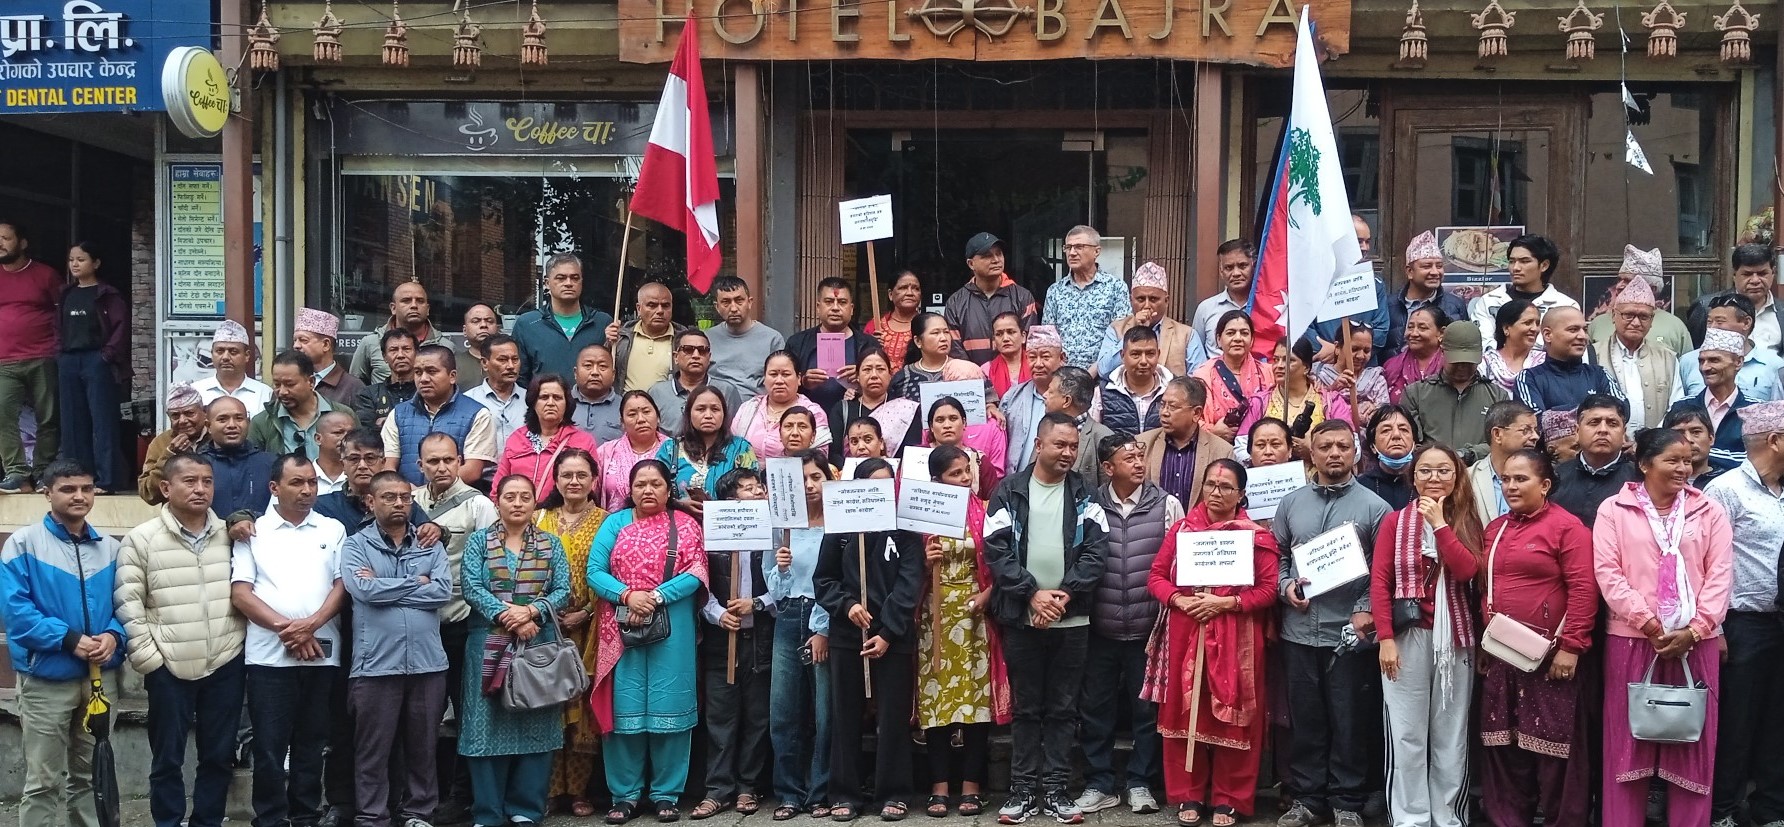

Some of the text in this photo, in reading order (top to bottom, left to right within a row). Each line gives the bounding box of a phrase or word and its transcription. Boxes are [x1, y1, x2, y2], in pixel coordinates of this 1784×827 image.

[63, 0, 134, 52] लि.
[47, 62, 95, 79] उपचार
[100, 56, 137, 79] केन्द्र
[7, 86, 137, 107] DENTAL CENTER
[190, 90, 216, 110] Coffee
[505, 117, 579, 145] Coffee
